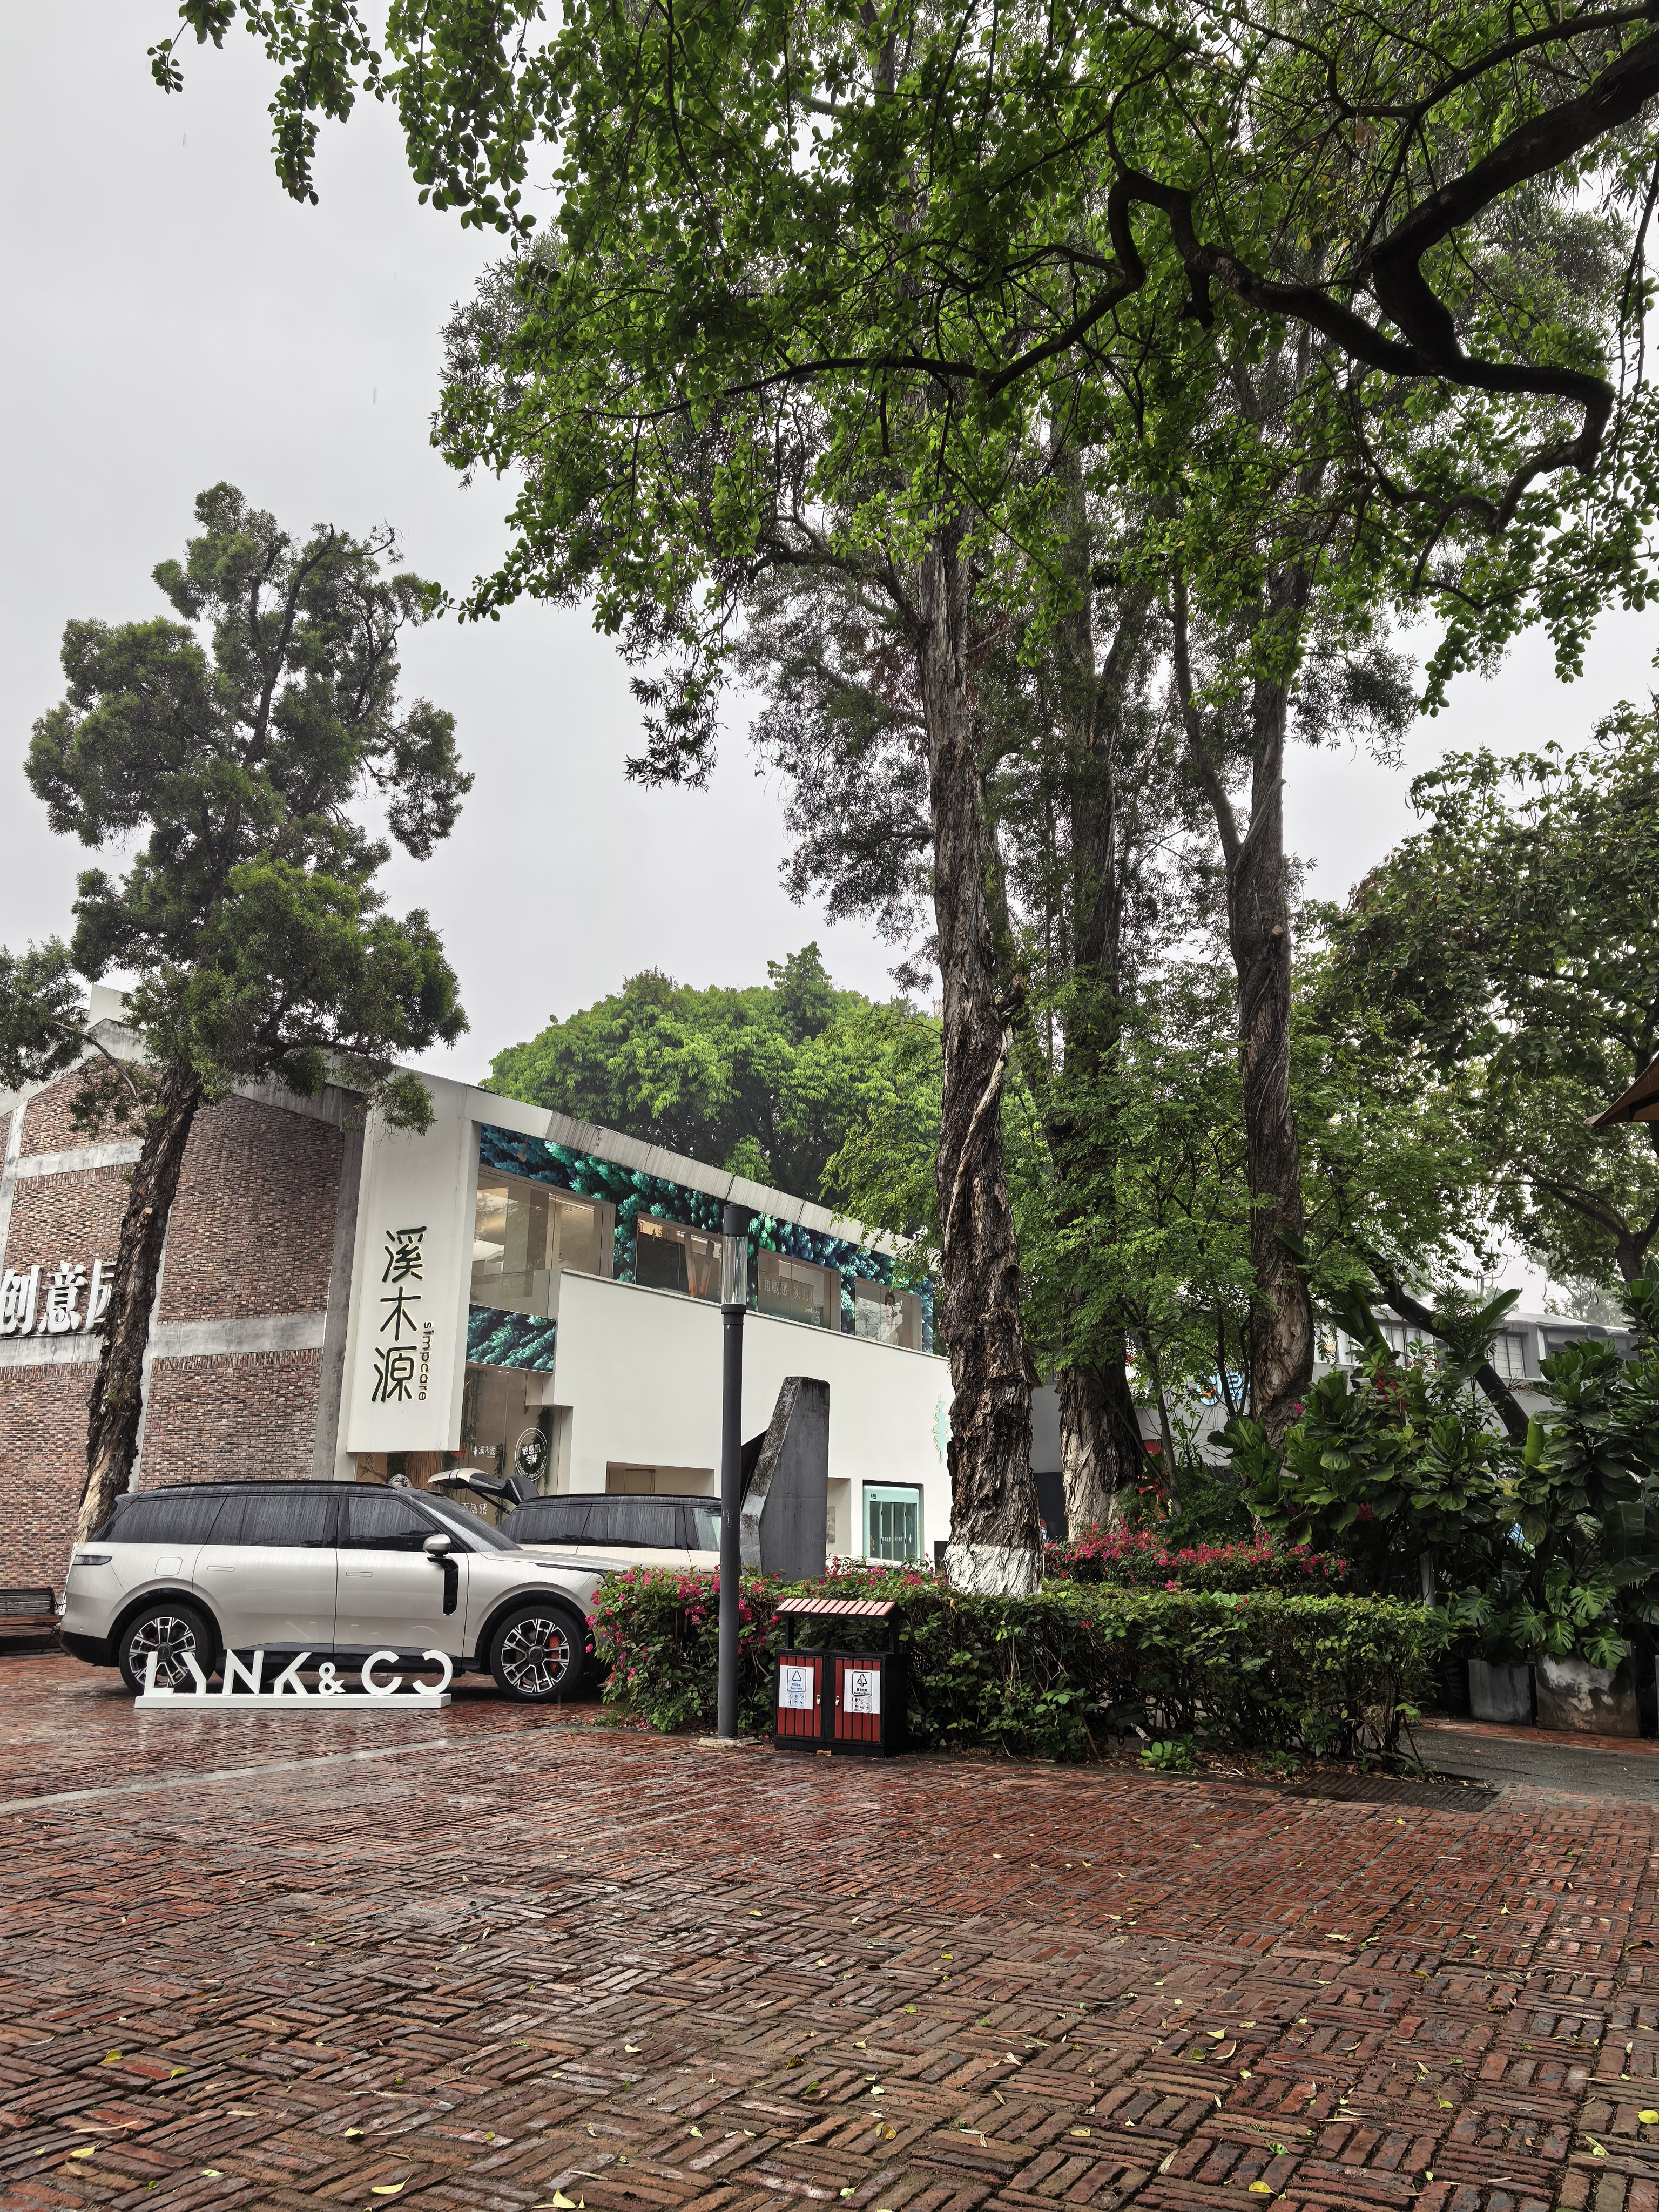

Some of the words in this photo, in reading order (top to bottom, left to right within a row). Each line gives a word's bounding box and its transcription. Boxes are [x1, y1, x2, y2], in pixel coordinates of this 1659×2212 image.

[372, 1225, 427, 1402] 溪木源
[417, 1321, 435, 1401] simpcare
